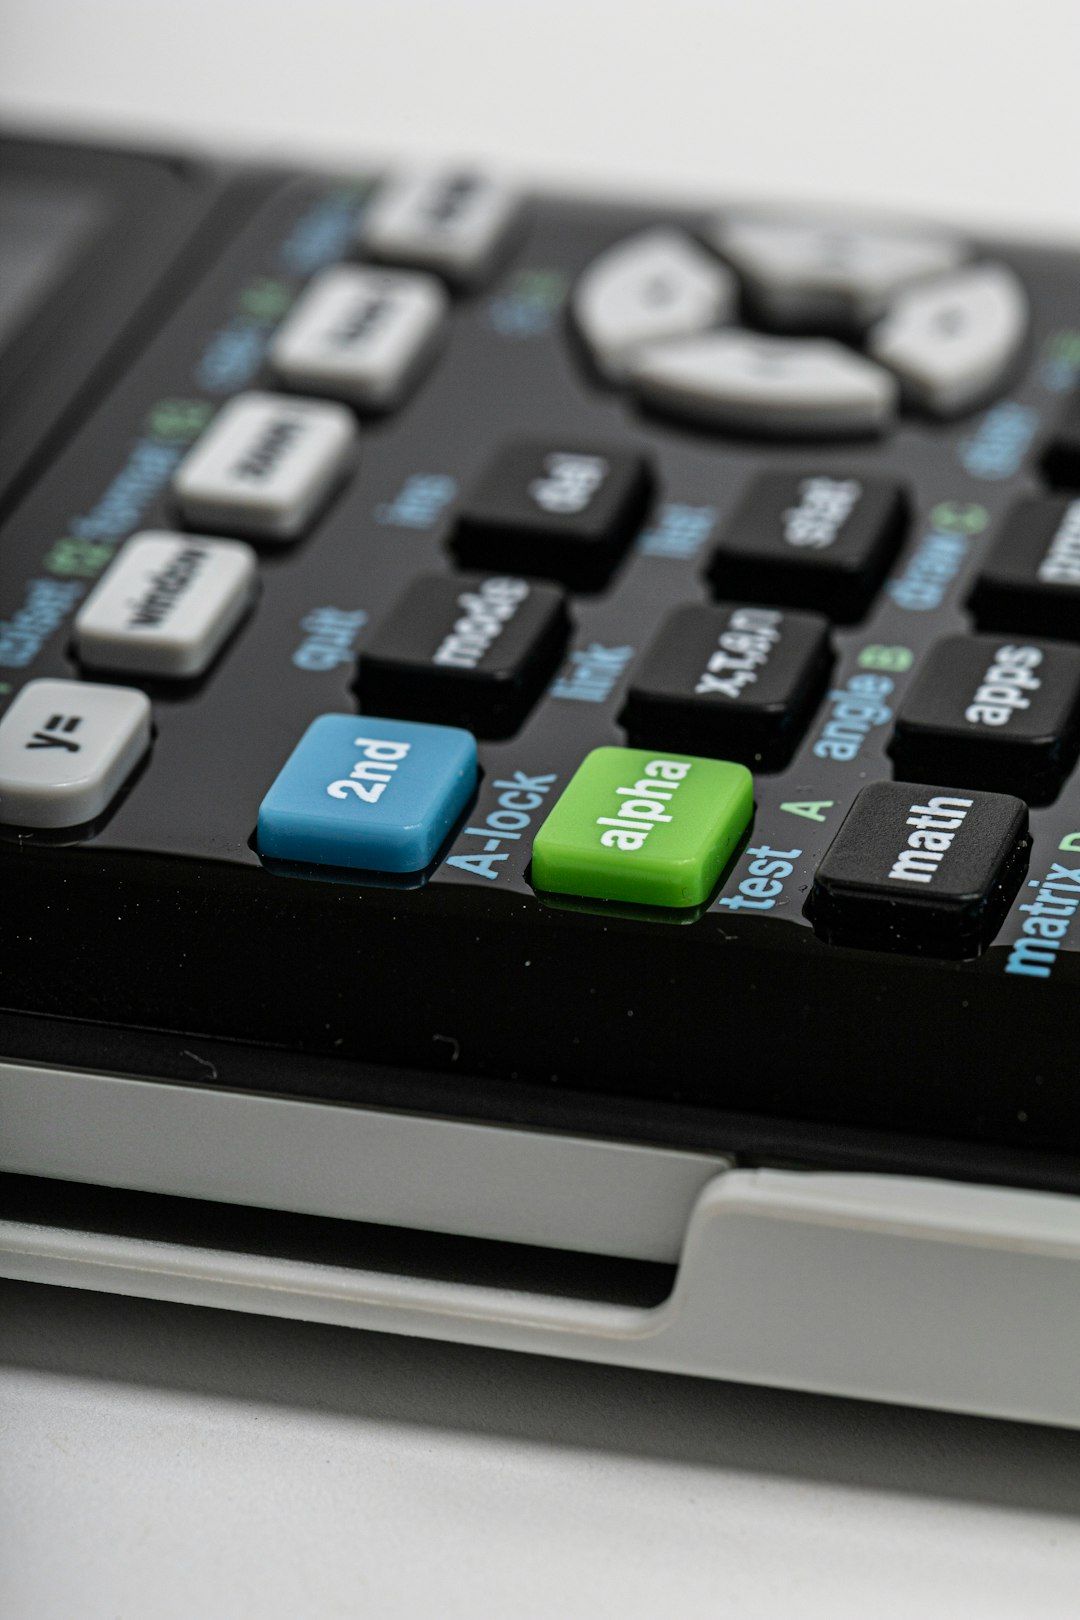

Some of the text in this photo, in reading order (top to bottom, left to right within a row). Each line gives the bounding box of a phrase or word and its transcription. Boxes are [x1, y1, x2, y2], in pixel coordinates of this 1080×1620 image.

[432, 576, 530, 668] mode
[812, 672, 895, 762] angle
[964, 645, 1043, 727] apps
[25, 714, 83, 754] y=
[326, 737, 411, 804] 2nd
[445, 770, 557, 881] A-lock
[596, 759, 692, 852] alpha
[888, 795, 975, 884] math
[718, 800, 834, 911] test A
[1004, 862, 1080, 978] matrix
